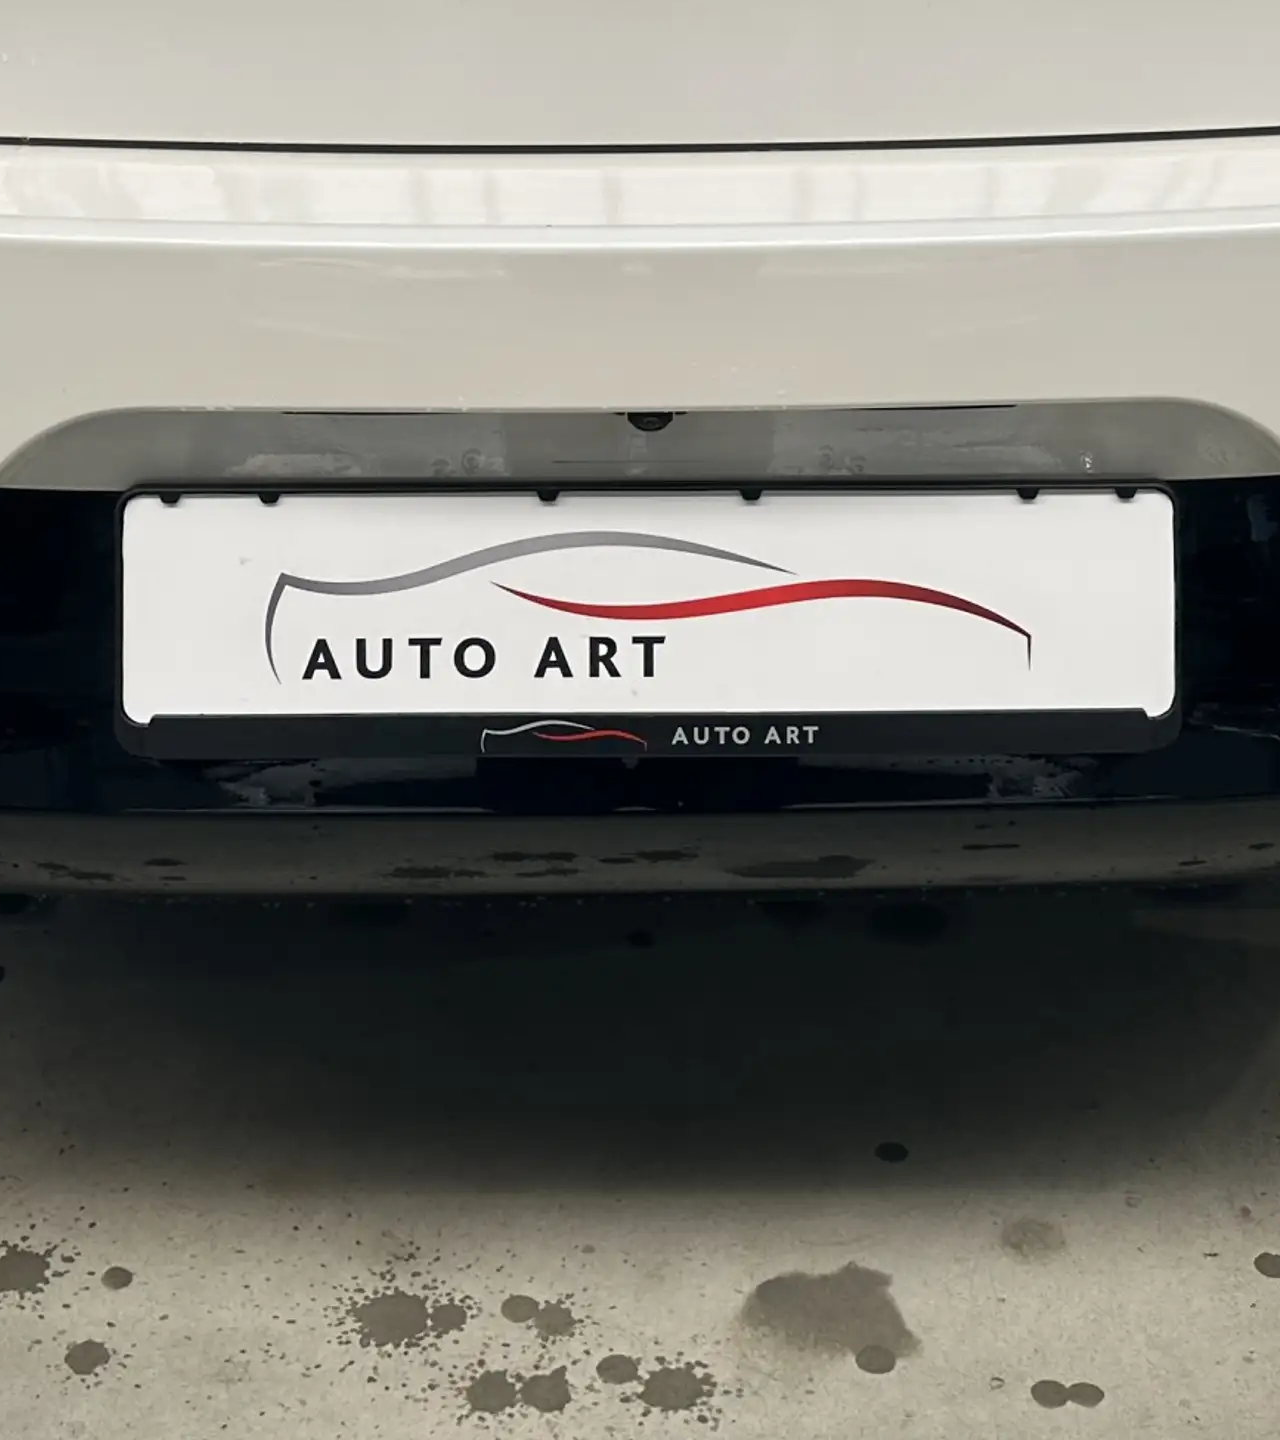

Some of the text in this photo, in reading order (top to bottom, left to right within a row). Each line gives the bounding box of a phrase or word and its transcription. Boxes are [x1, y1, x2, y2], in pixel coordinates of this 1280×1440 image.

[301, 635, 667, 680] AUTO ART
[671, 726, 820, 746] AUTO ART
